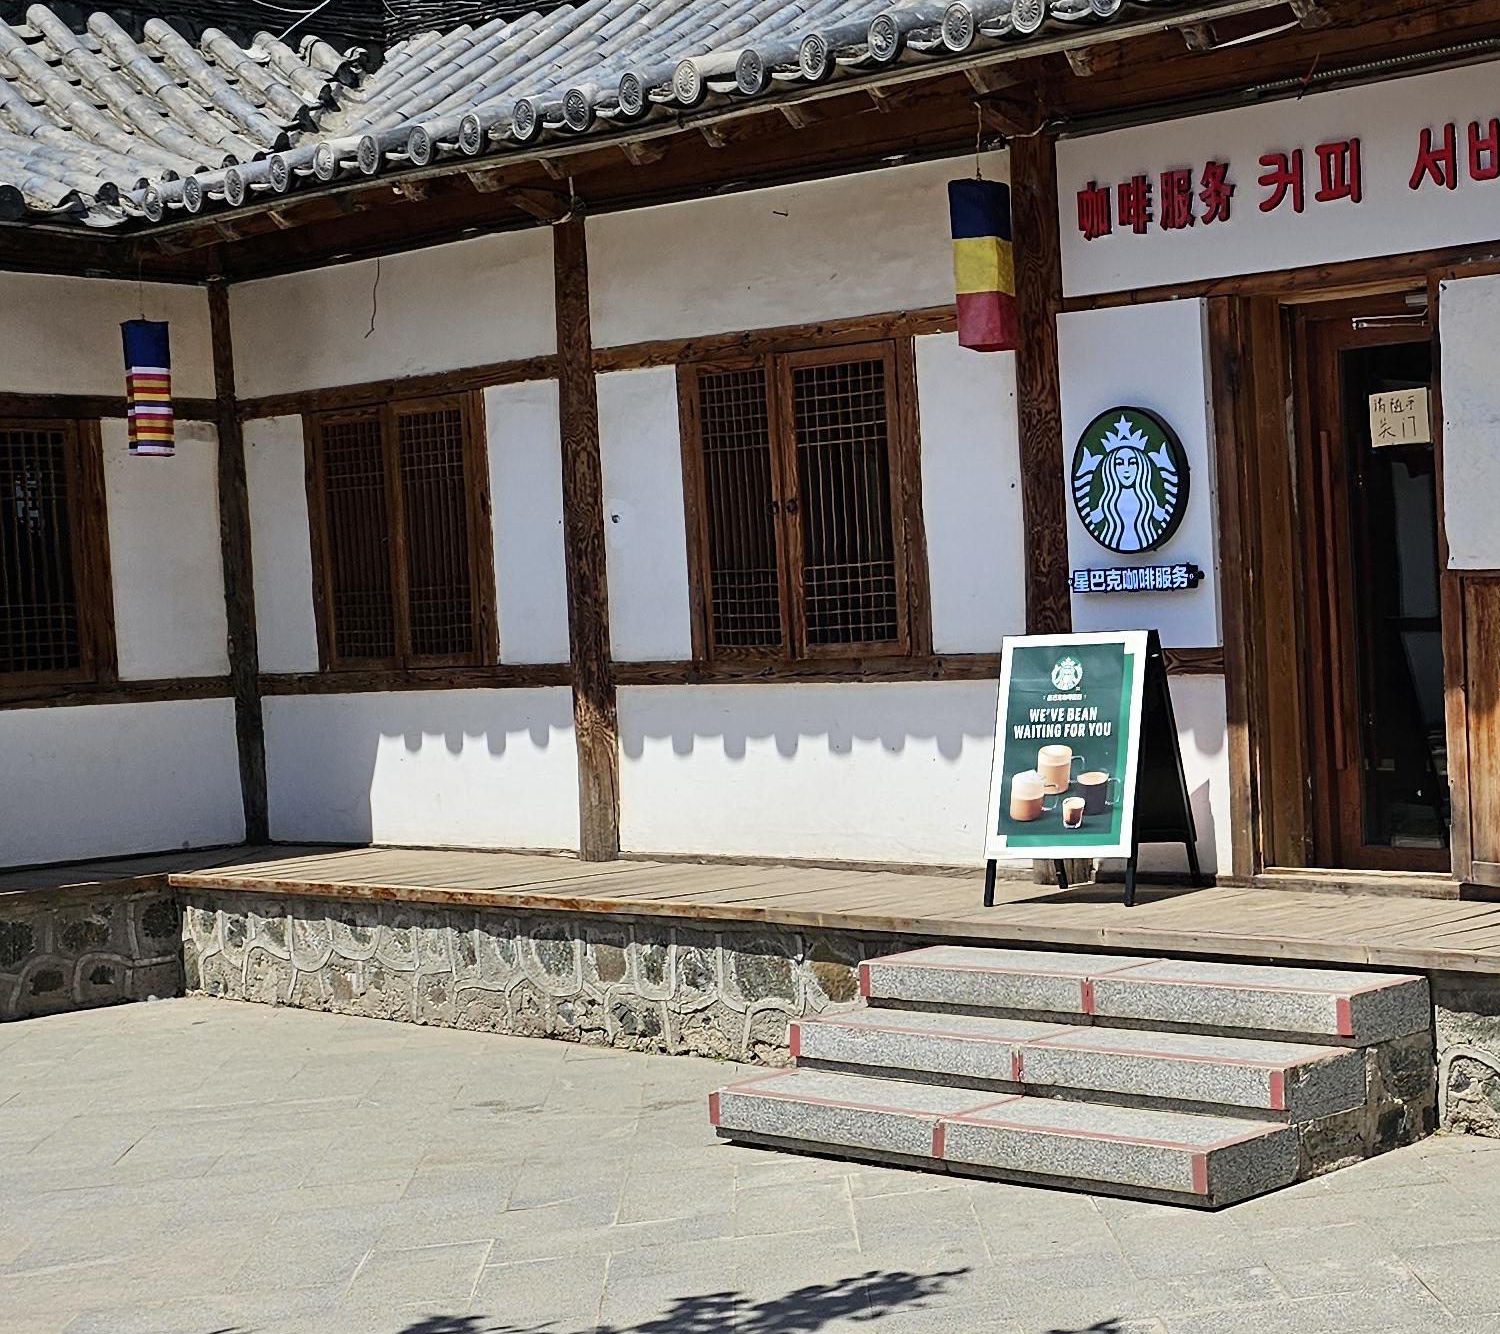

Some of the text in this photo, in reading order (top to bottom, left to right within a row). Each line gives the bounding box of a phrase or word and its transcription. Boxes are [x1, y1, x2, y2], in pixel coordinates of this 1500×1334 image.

[1077, 160, 1236, 241] 咖啡服务
[1257, 137, 1362, 213] 커피
[1374, 395, 1415, 413] 请随手
[1378, 417, 1417, 438] 关门
[1073, 566, 1189, 592] 星巴克咖啡服务
[1029, 706, 1098, 723] WE'VE BEAN
[1013, 721, 1112, 740] WAITING FOR YOU
